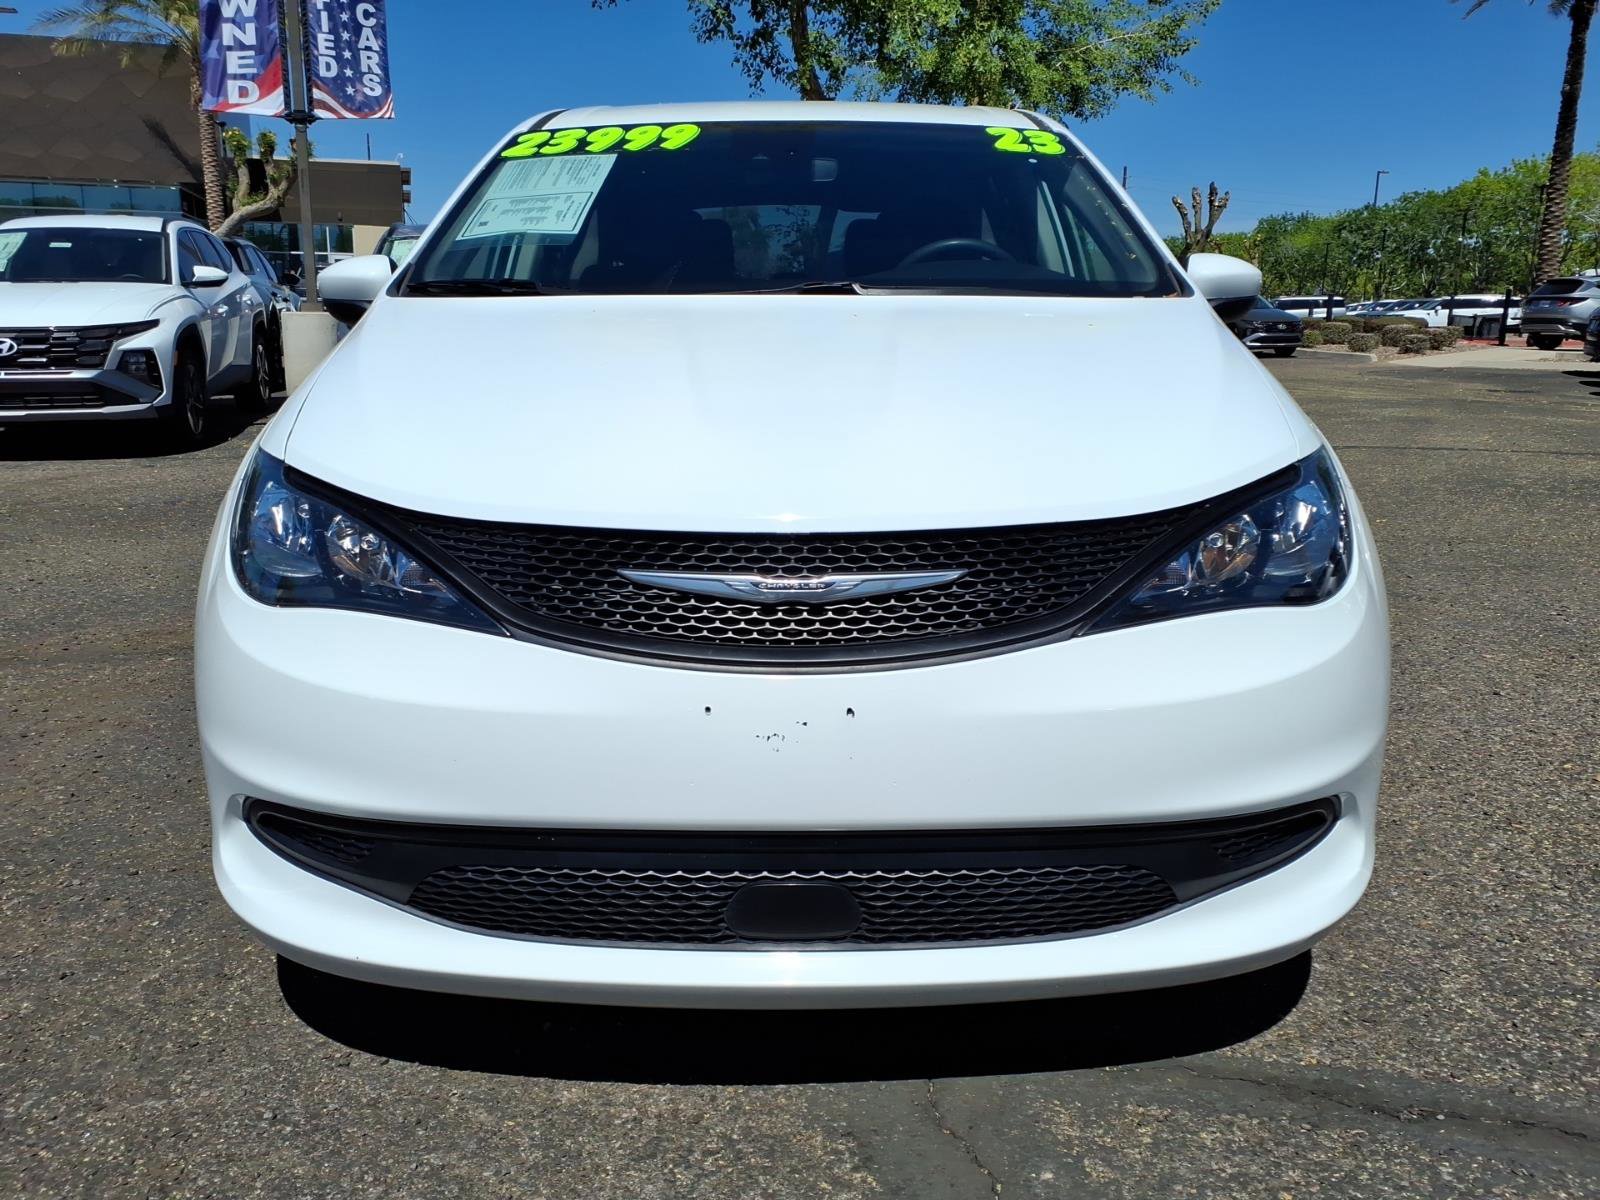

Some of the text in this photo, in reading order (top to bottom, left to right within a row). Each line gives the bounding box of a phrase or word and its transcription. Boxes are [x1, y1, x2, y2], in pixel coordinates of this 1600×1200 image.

[219, 0, 260, 104] WNED
[355, 2, 382, 97] CARS
[500, 123, 701, 158] 23999
[985, 127, 1066, 155] 23
[758, 582, 826, 590] CHRYSLER
